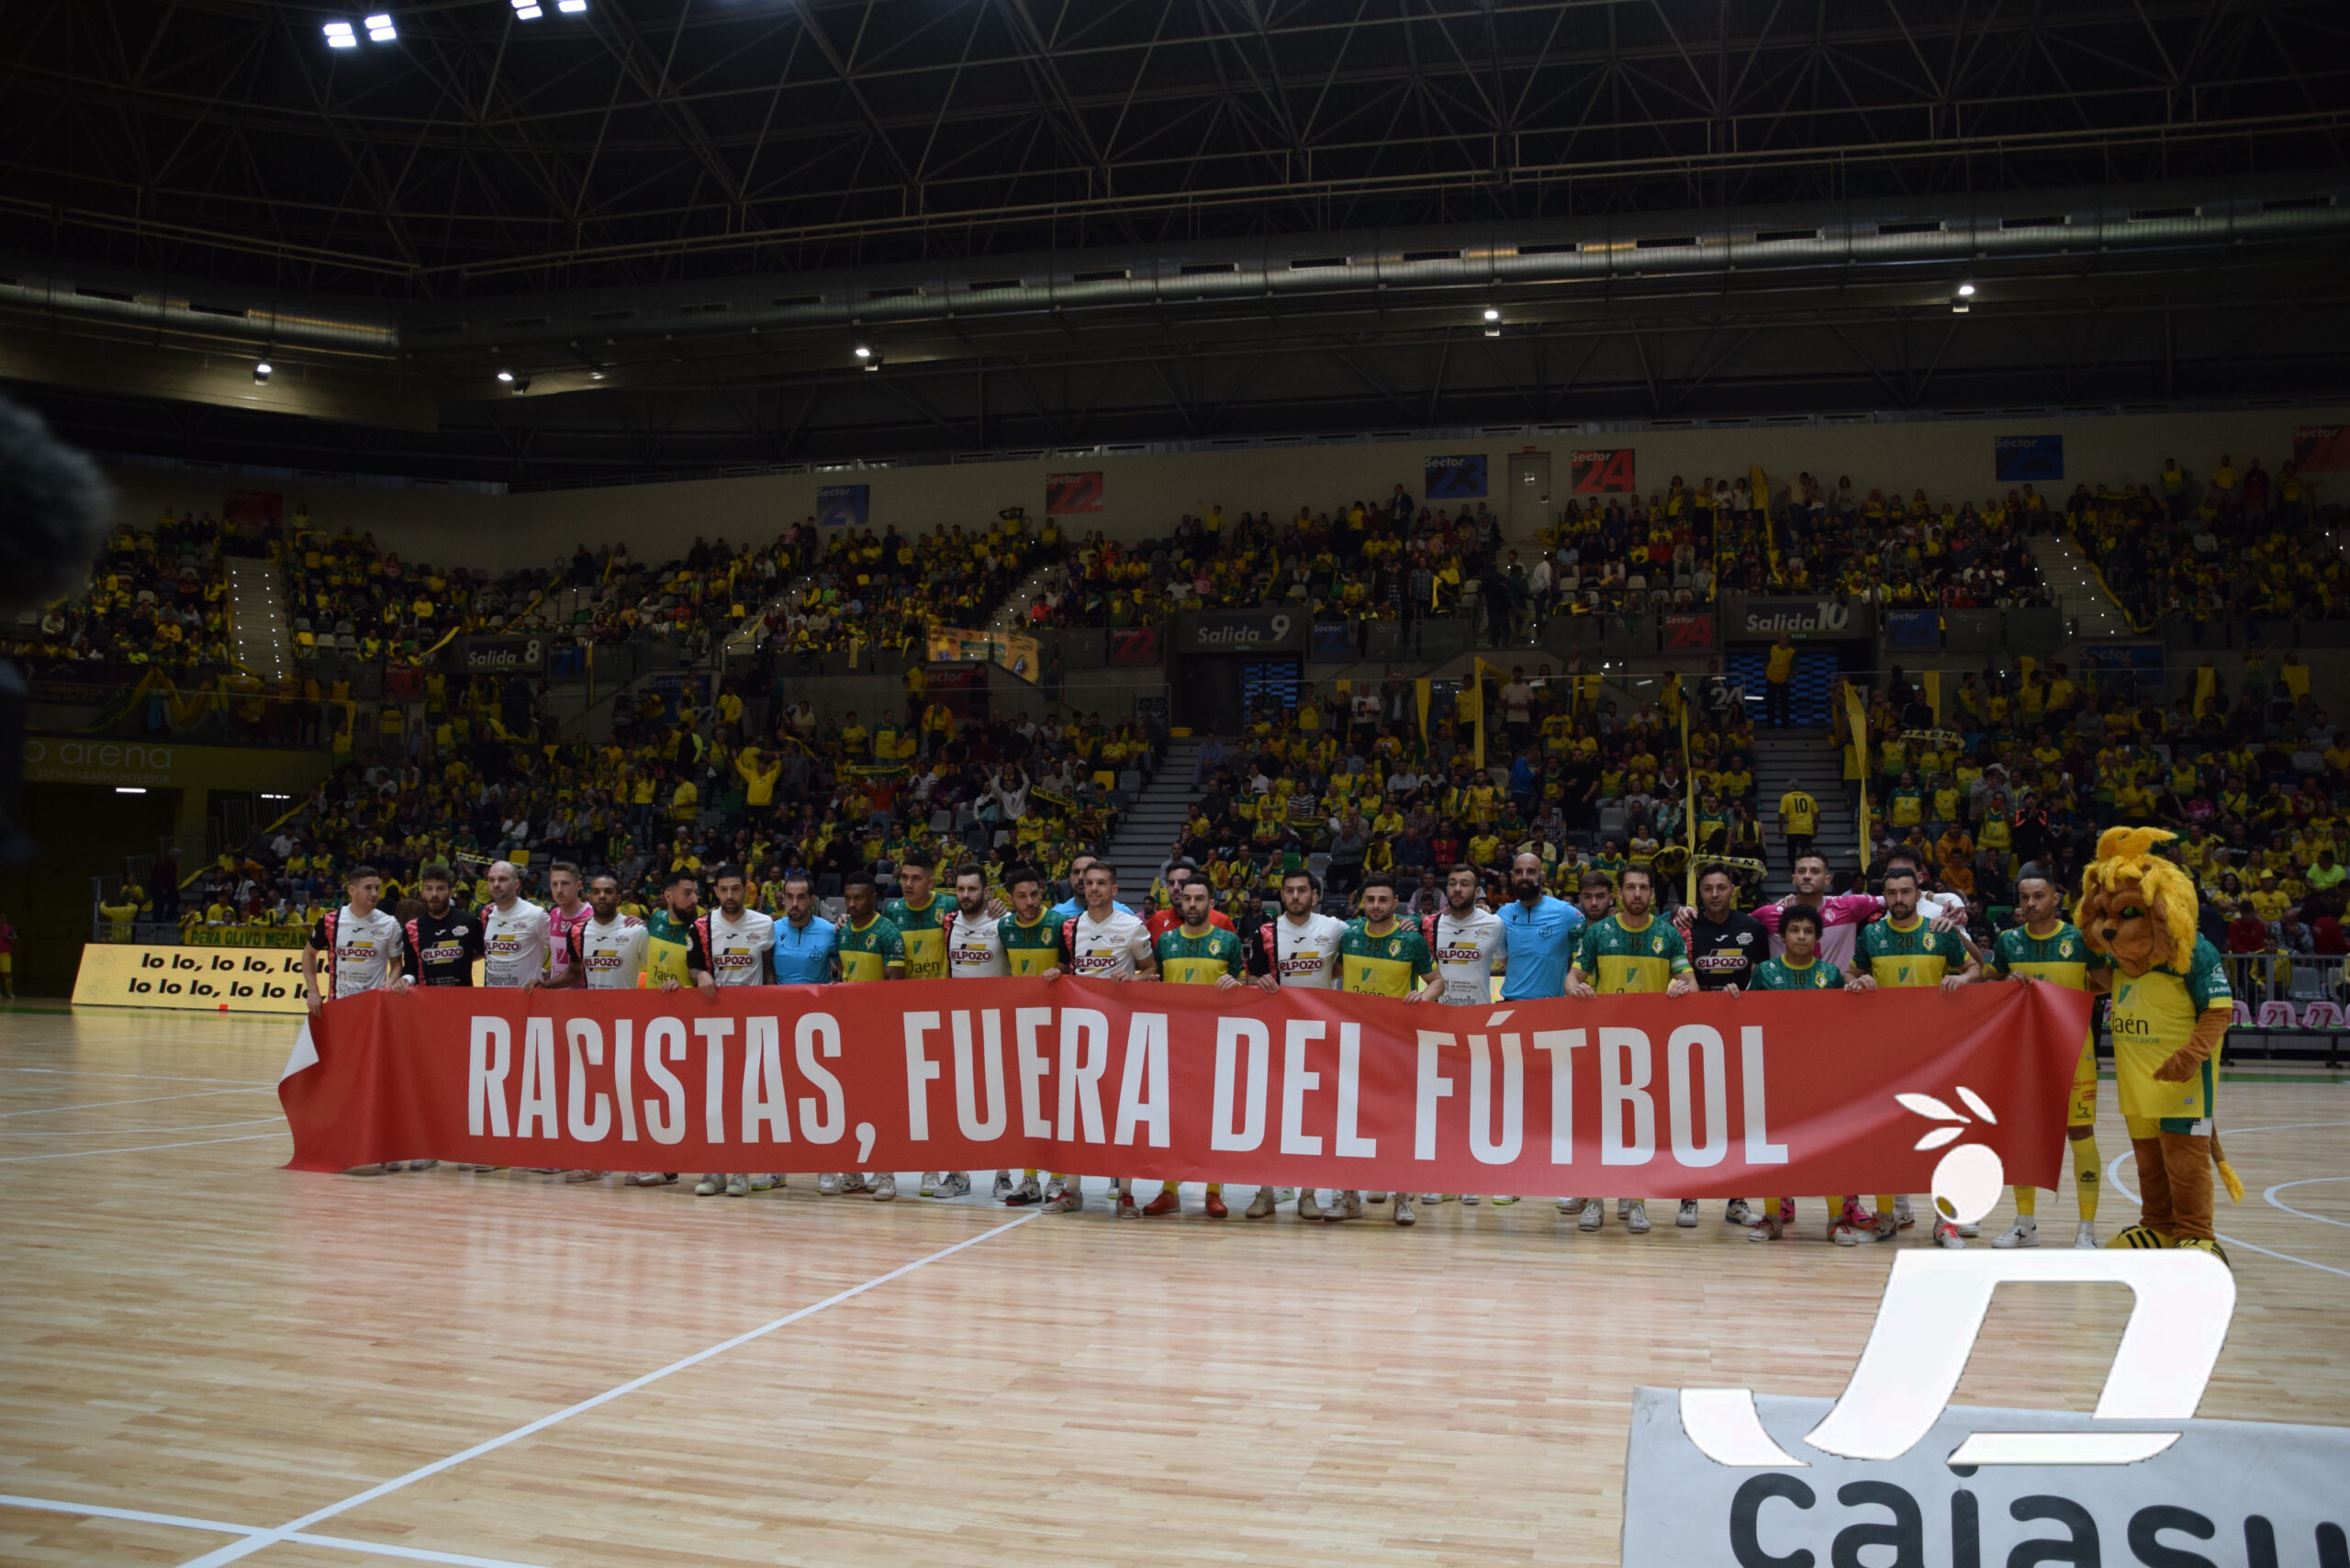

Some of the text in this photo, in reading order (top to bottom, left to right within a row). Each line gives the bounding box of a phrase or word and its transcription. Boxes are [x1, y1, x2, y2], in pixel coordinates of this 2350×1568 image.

[2293, 426, 2339, 439] Sector
[1994, 436, 2038, 449] Sector
[1425, 456, 1465, 468] Sector
[1571, 451, 1612, 463] Sector
[1425, 455, 1488, 498] 23
[1571, 450, 1635, 494] 24
[1046, 474, 1083, 486] Sector
[817, 486, 852, 498] Sector
[1046, 472, 1102, 515] 22
[1665, 615, 1695, 625] Sector
[1746, 601, 1850, 632] Salida 10
[1888, 610, 1919, 622] Sector
[1113, 629, 1140, 638] Sector
[1197, 614, 1291, 644] Salida 9
[1314, 624, 1342, 633] Sector
[1667, 615, 1713, 647] 24
[1113, 628, 1157, 660] 22
[468, 640, 541, 666] Salida 8
[650, 677, 683, 689] Secto
[927, 671, 964, 683] ector
[1710, 687, 1744, 705] 24
[60, 743, 172, 769] arena
[1794, 797, 1808, 814] 10
[224, 930, 261, 946] OLIVO
[1365, 938, 1382, 952] 29
[1629, 936, 1642, 949] 14
[1897, 935, 1914, 948] 20
[1186, 939, 1201, 953] 21
[2034, 943, 2049, 957] 12
[141, 953, 165, 969] lo
[172, 954, 203, 972] lo,
[211, 955, 235, 971] lo
[242, 956, 275, 974] lo,
[906, 958, 941, 973] Jaén
[1792, 972, 1807, 986] 10
[129, 978, 151, 993] lo
[159, 979, 182, 994] lo
[189, 980, 221, 998] lo,
[229, 981, 253, 997] lo
[262, 982, 285, 998] lo
[2111, 1012, 2149, 1035] Jaén
[2266, 1009, 2288, 1027] 21
[2310, 1008, 2333, 1027] 27
[469, 1007, 1789, 1169] RACISTAS, FUERA DEL FÚTBOL
